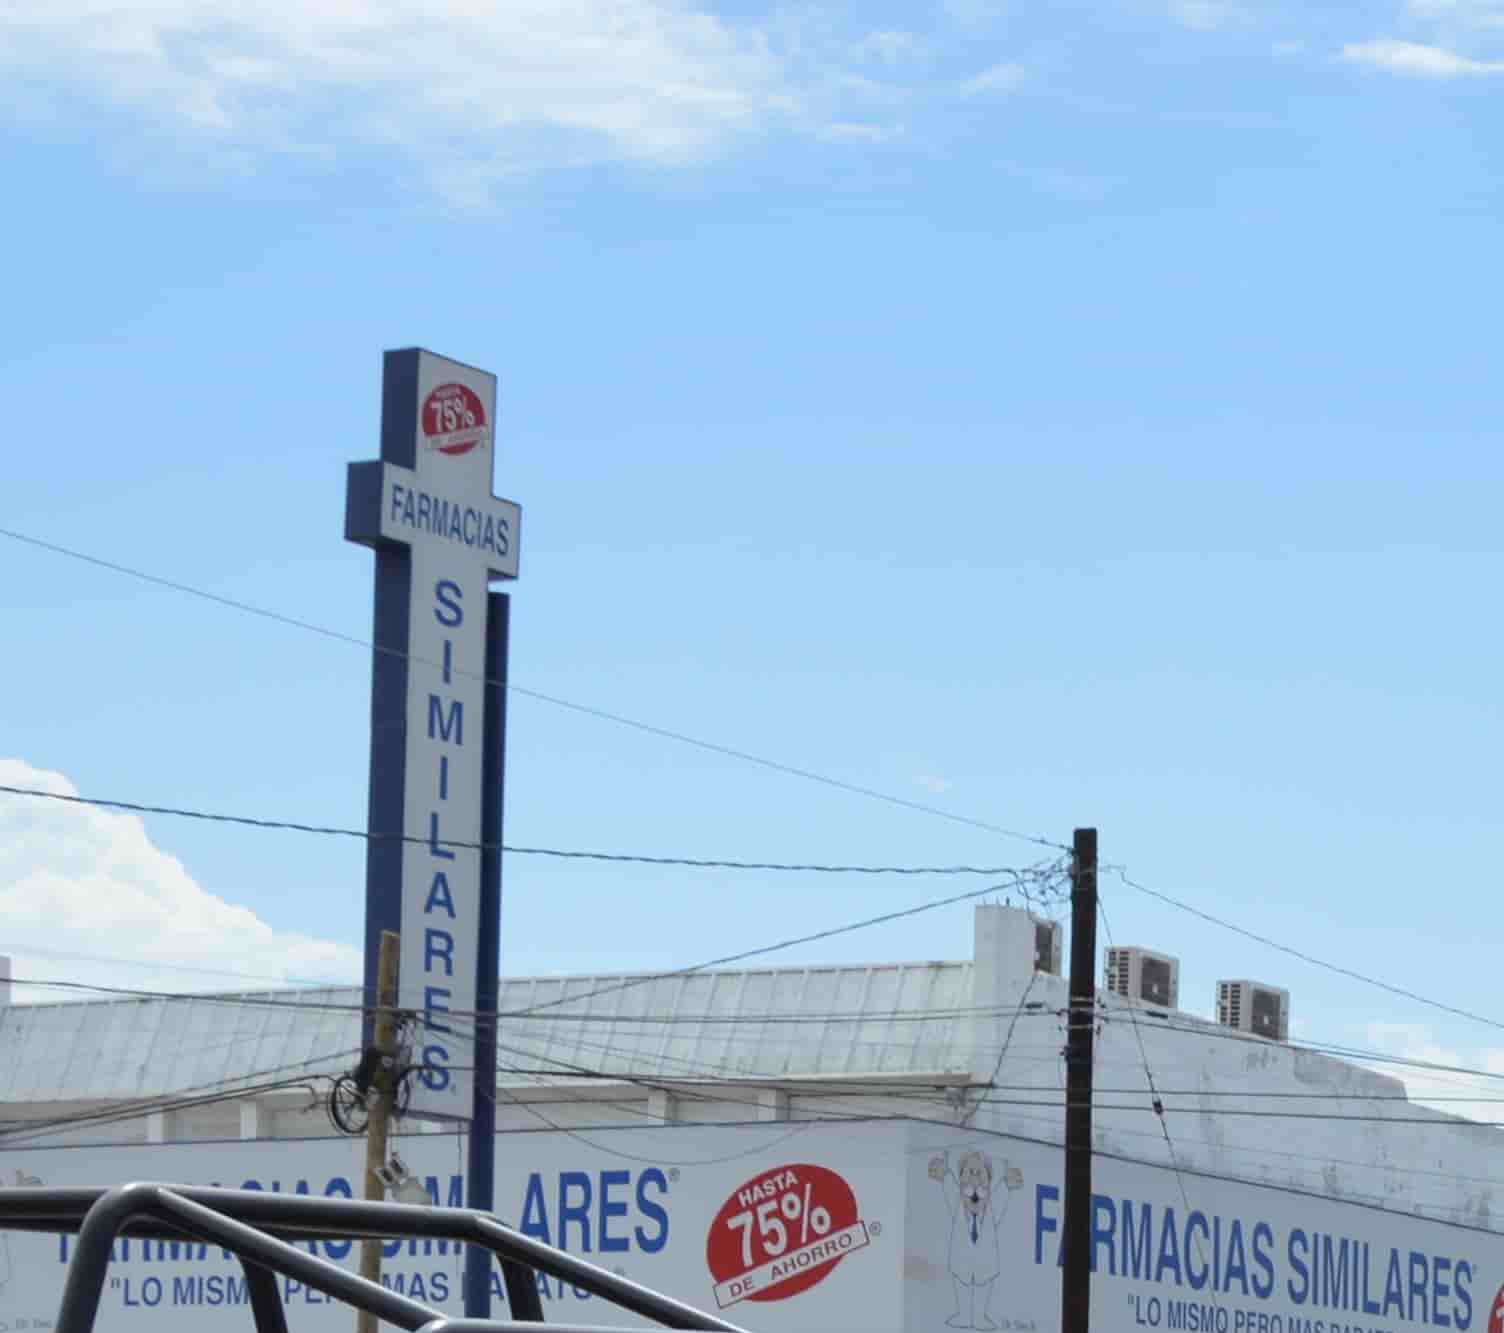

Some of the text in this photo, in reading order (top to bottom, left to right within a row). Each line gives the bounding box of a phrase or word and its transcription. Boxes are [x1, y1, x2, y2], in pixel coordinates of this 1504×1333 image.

[430, 398, 475, 434] 75%
[391, 482, 509, 556] FARMACIAS
[418, 576, 465, 1094] SIMILARES
[738, 1170, 798, 1208] HASTA
[727, 1185, 832, 1268] 75%
[1034, 1183, 1473, 1332] FRMACIAS SIMILARES
[173, 1276, 251, 1306] MISM
[727, 1231, 854, 1297] DE AHORRO
